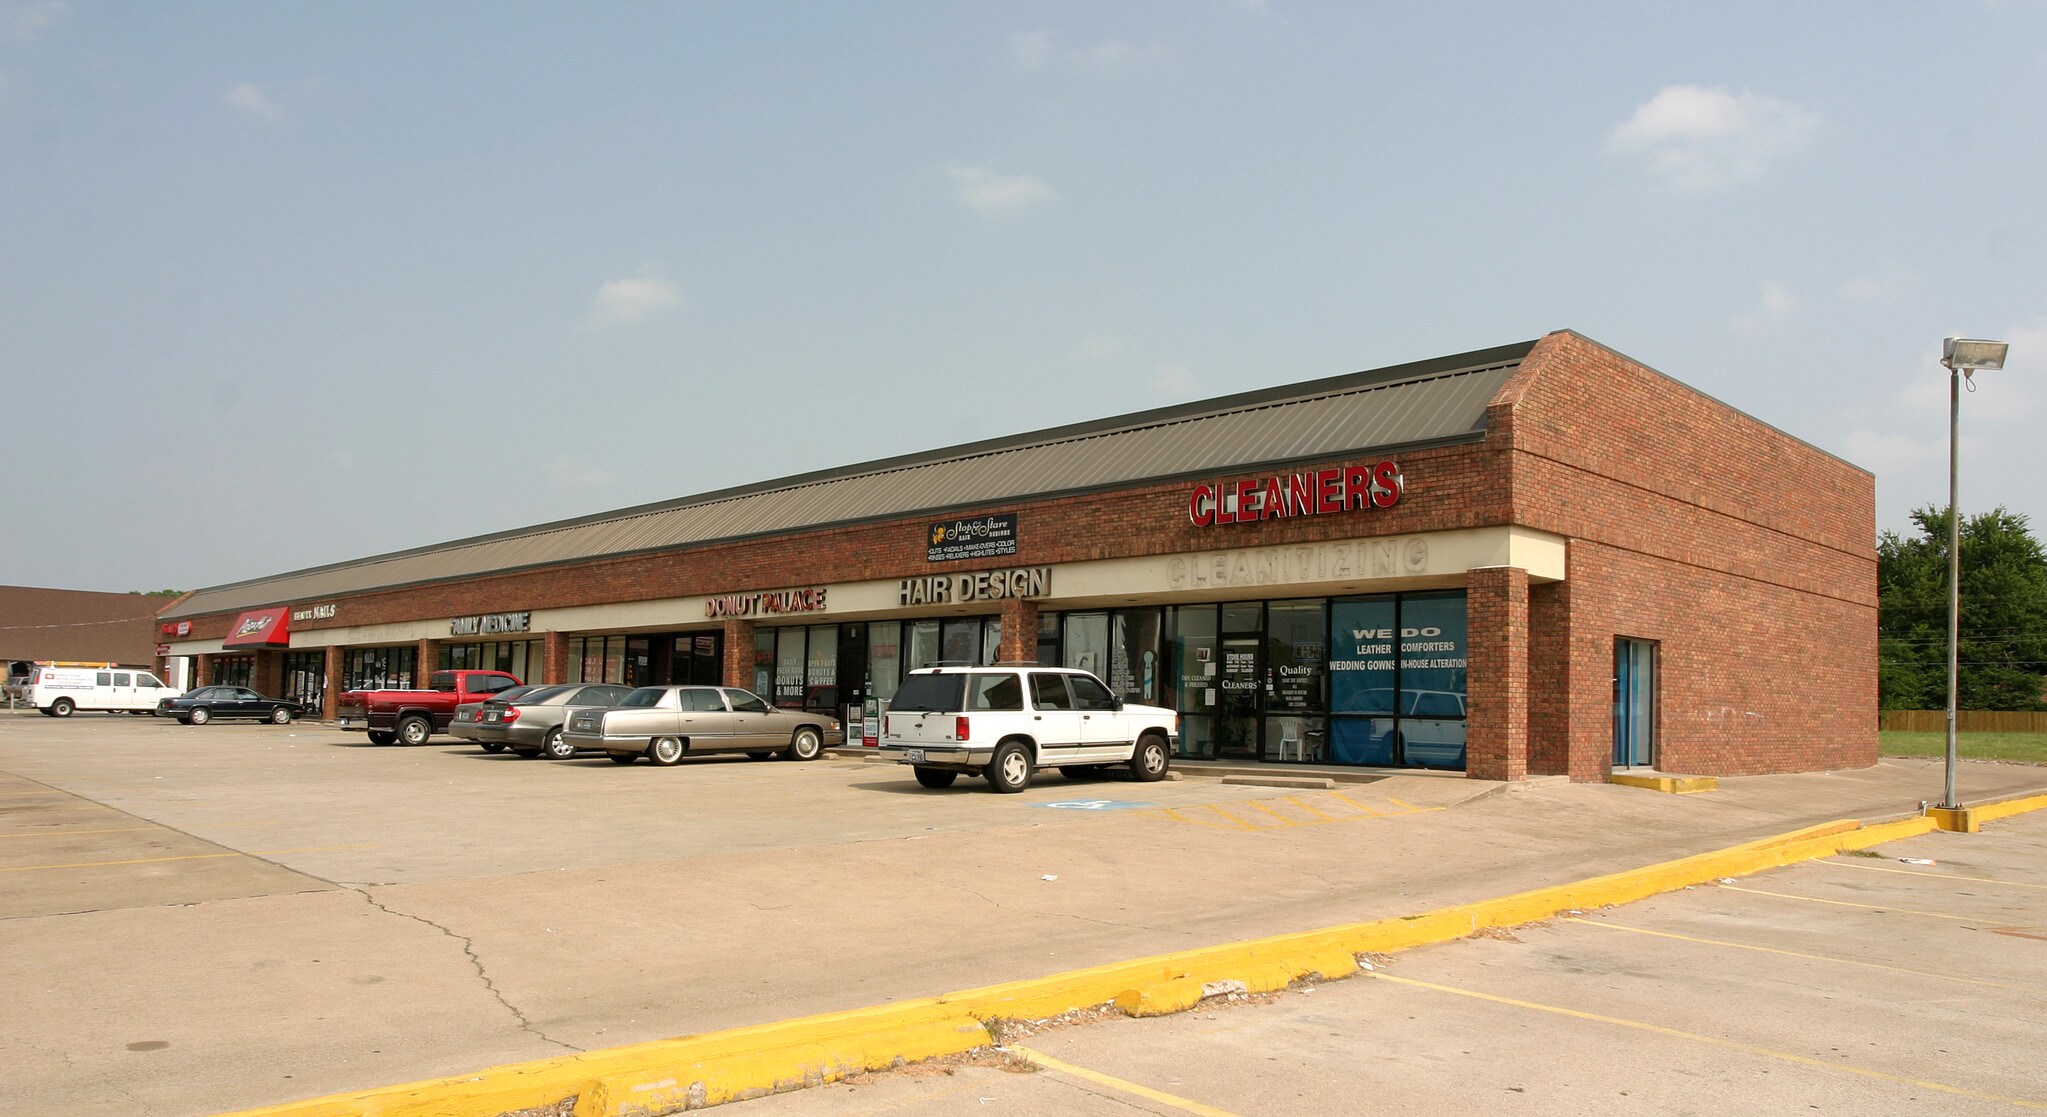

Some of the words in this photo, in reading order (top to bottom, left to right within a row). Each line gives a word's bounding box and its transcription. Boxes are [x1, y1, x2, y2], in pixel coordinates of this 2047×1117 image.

[1189, 461, 1402, 527] CLEANERS
[1166, 537, 1429, 588] CLEANITIZING
[899, 576, 952, 606] HAIR
[958, 568, 1051, 601] DESIGN
[705, 594, 760, 617] DONUT
[761, 589, 827, 613] PALACE
[450, 616, 481, 635] FAMILY
[480, 612, 531, 633] MEDICINE
[1353, 629, 1392, 639] WE
[1401, 627, 1441, 637] DO
[1357, 644, 1391, 654] LEATHER
[1401, 642, 1454, 652] COMFORTERS
[1329, 660, 1365, 670] WEDDING
[1367, 660, 1395, 670] GOWNS
[1401, 660, 1429, 669] IN-HOUSE
[1280, 665, 1312, 676] Quality
[776, 676, 804, 685] DONUTS
[810, 677, 833, 685] COFFEE
[776, 686, 782, 695] &
[784, 686, 803, 696] MORE
